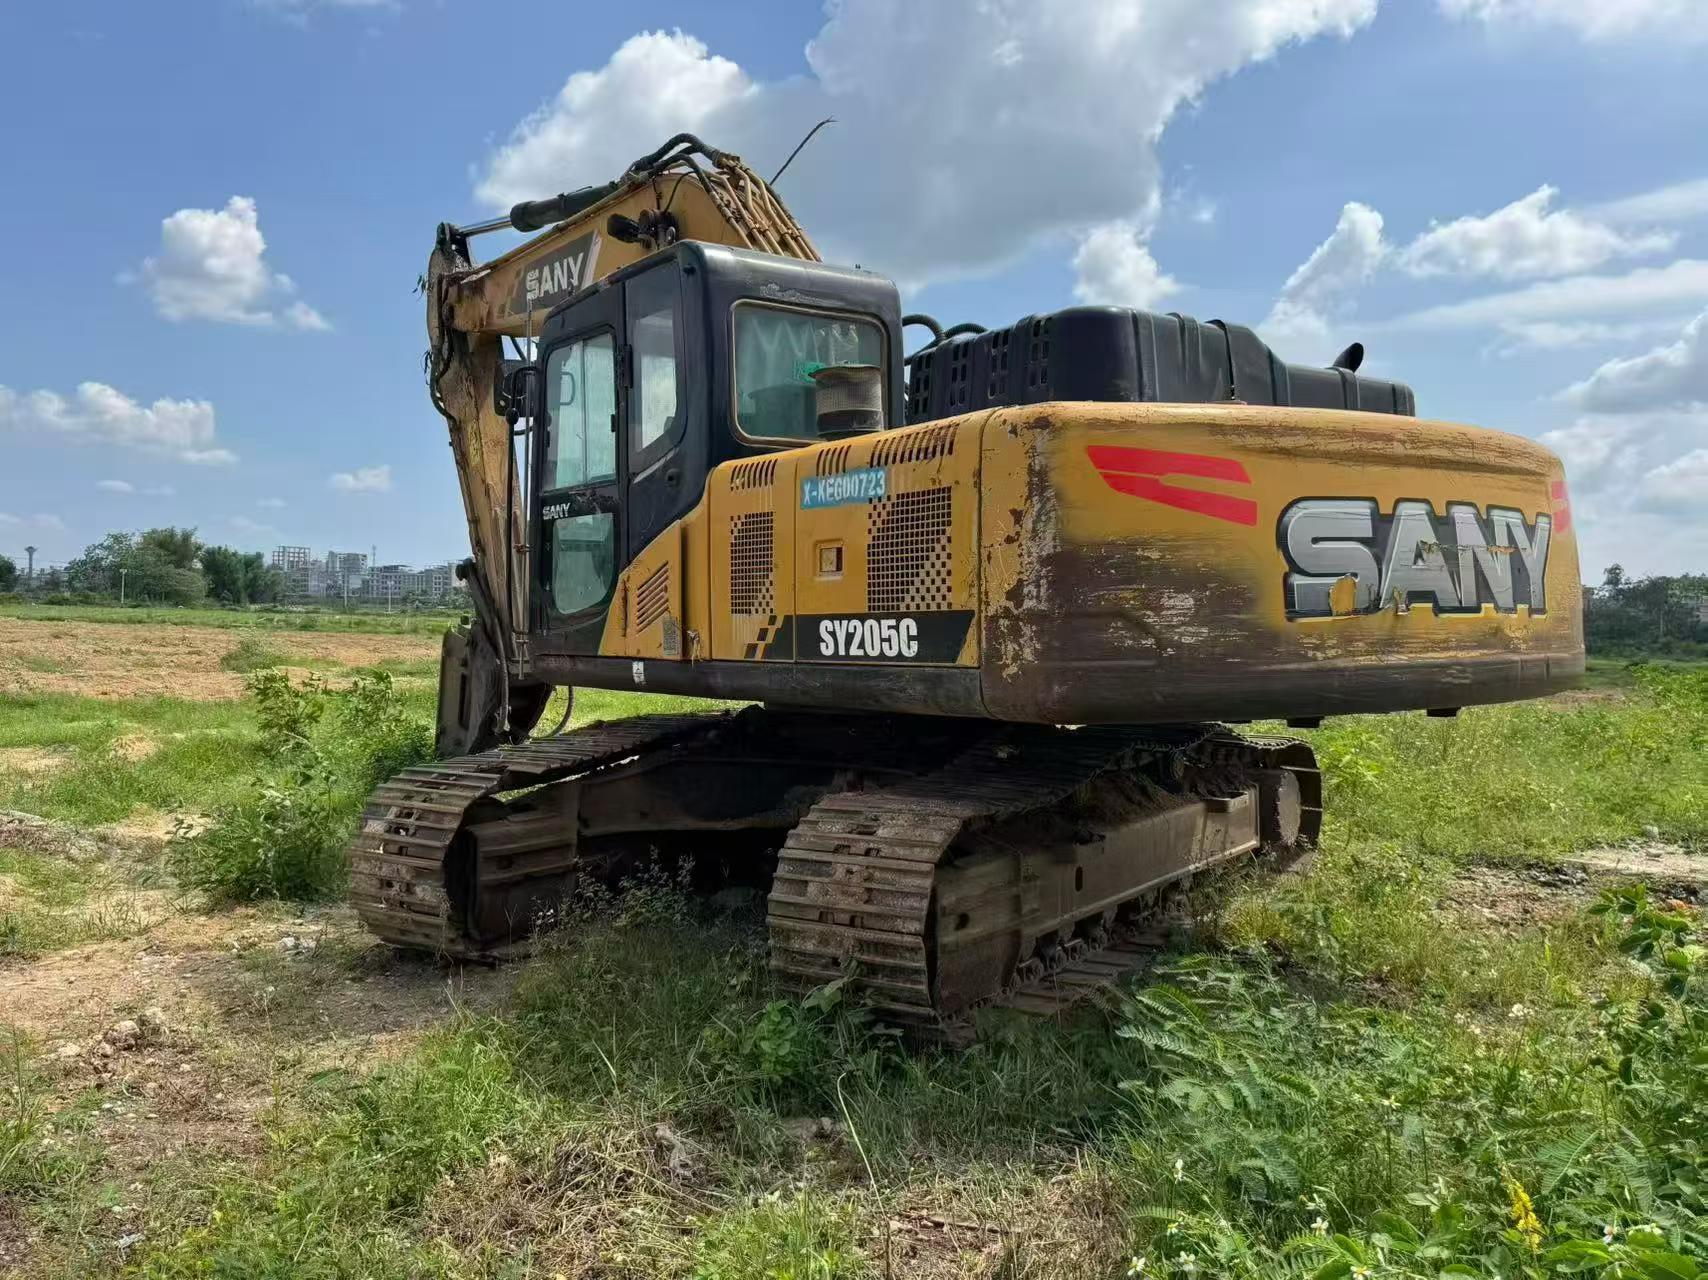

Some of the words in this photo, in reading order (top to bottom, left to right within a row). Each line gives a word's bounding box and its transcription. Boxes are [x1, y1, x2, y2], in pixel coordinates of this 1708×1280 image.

[526, 252, 584, 299] SANY
[543, 503, 570, 520] SANY
[1278, 498, 1551, 617] SANY
[819, 618, 918, 657] SY205C
